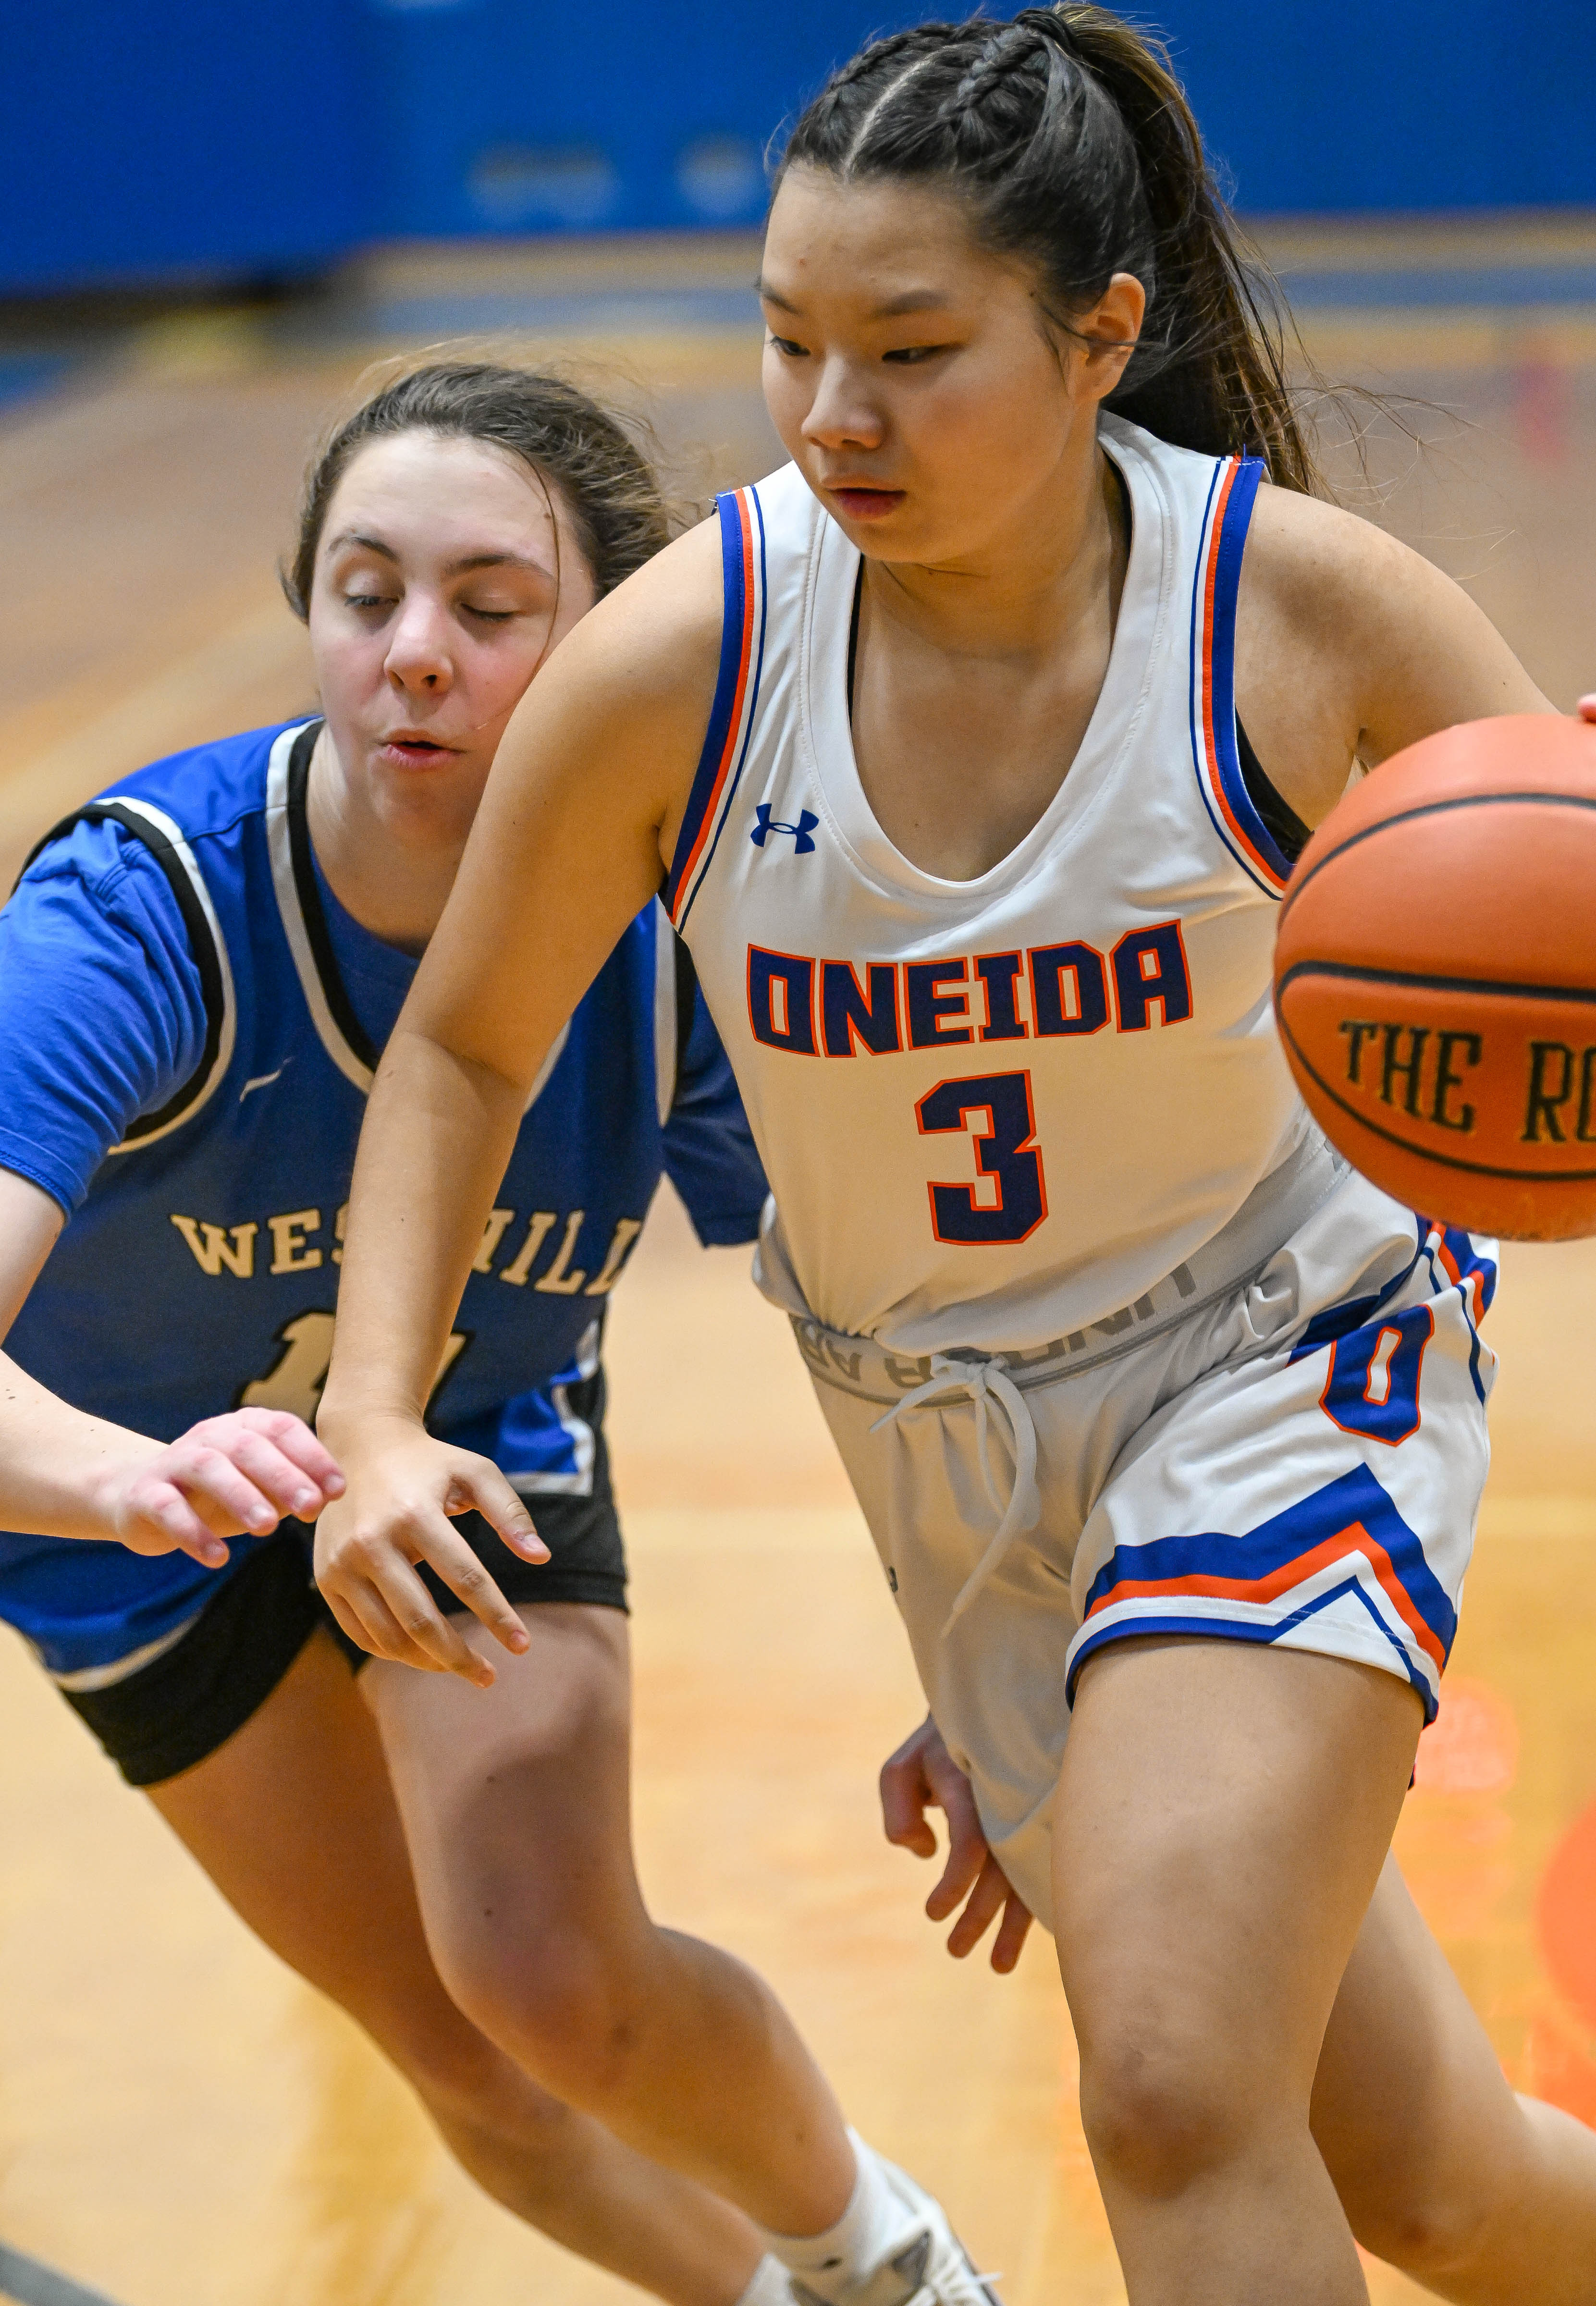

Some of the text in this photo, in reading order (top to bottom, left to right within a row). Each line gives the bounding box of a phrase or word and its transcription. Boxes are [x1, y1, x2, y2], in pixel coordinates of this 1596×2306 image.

[746, 918, 1194, 1058] ONEIDA
[1338, 1018, 1483, 1133] THE
[914, 1069, 1049, 1246] 3
[170, 1200, 643, 1297] WEILL
